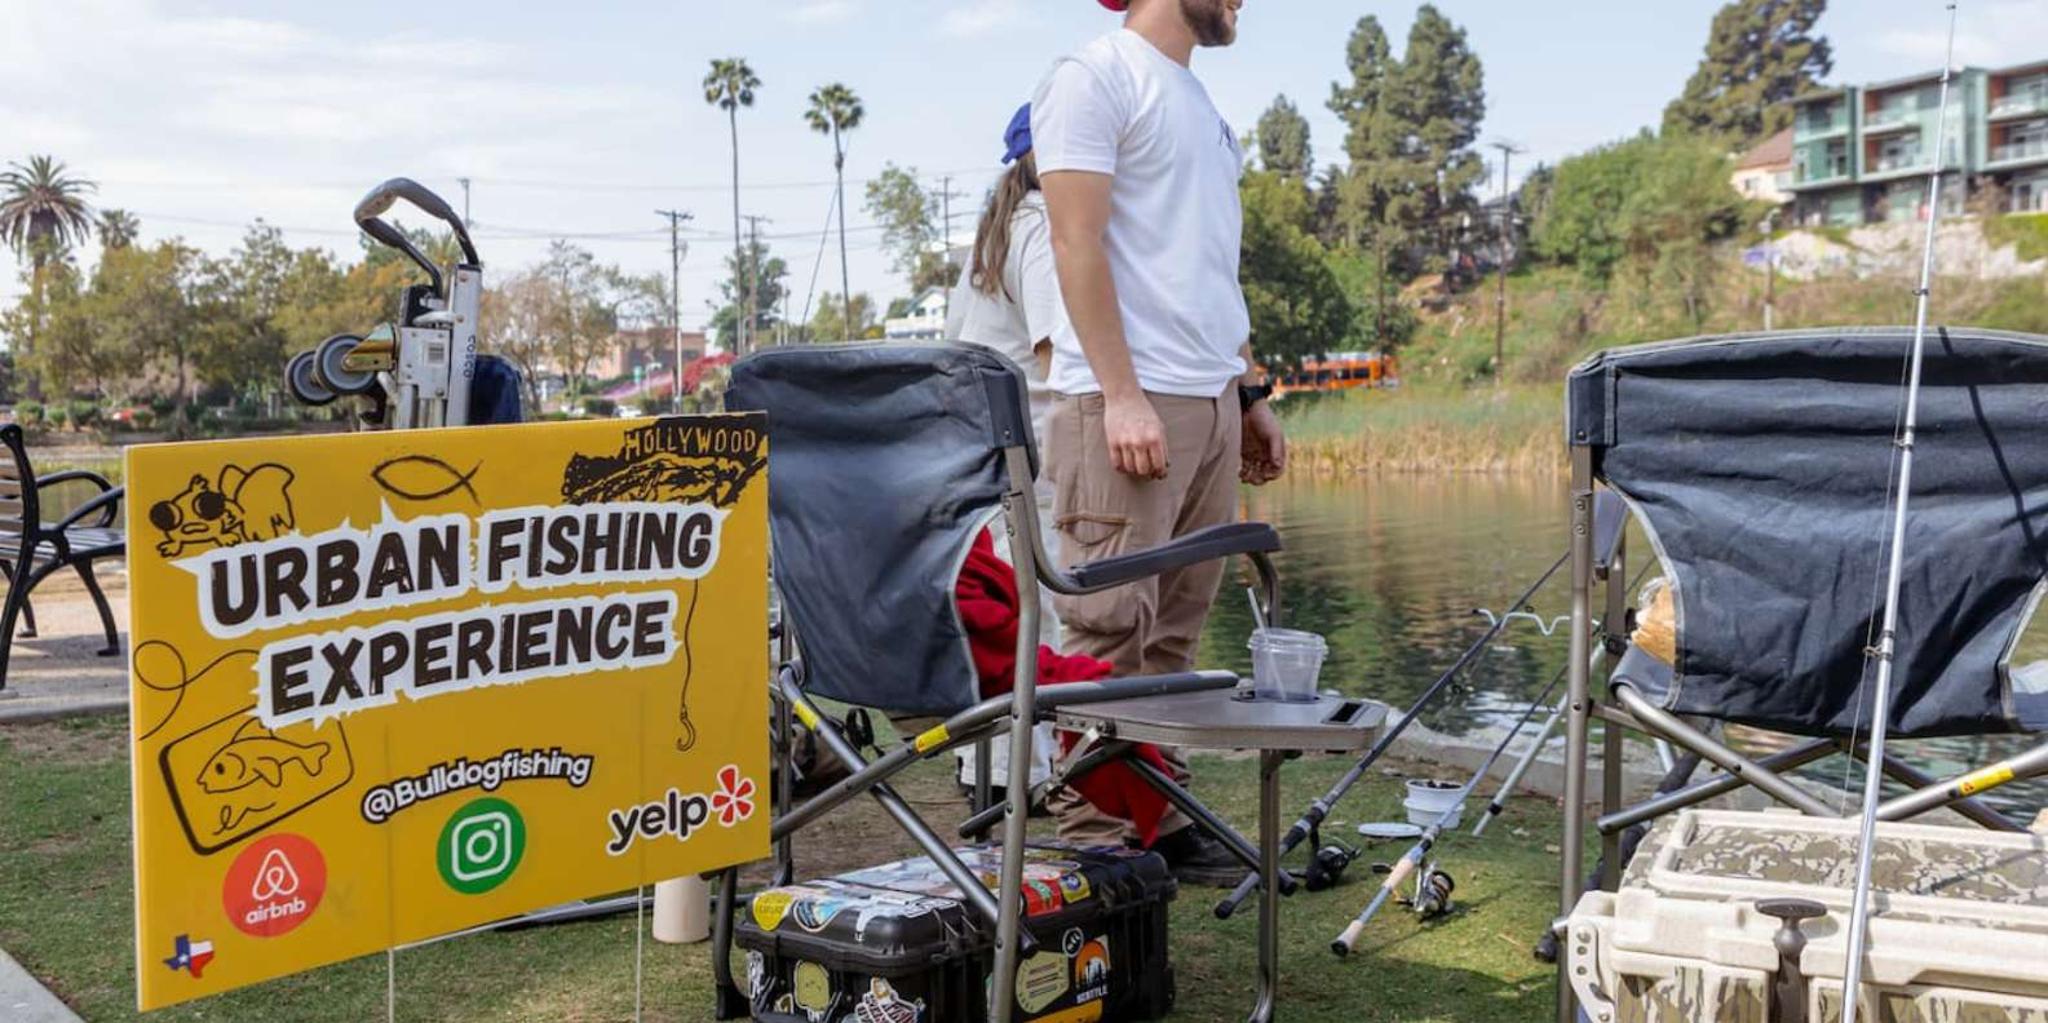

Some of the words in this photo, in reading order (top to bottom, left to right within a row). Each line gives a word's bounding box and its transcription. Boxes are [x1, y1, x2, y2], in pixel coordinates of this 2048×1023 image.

[623, 426, 757, 461] HOLLYWOOD
[209, 524, 460, 627] URBAN
[487, 511, 714, 583] FISHING
[270, 599, 671, 717] EXPERIENCE
[362, 748, 593, 822] @Bulldogfishing
[608, 790, 709, 853] yelp
[245, 897, 306, 924] airbnb
